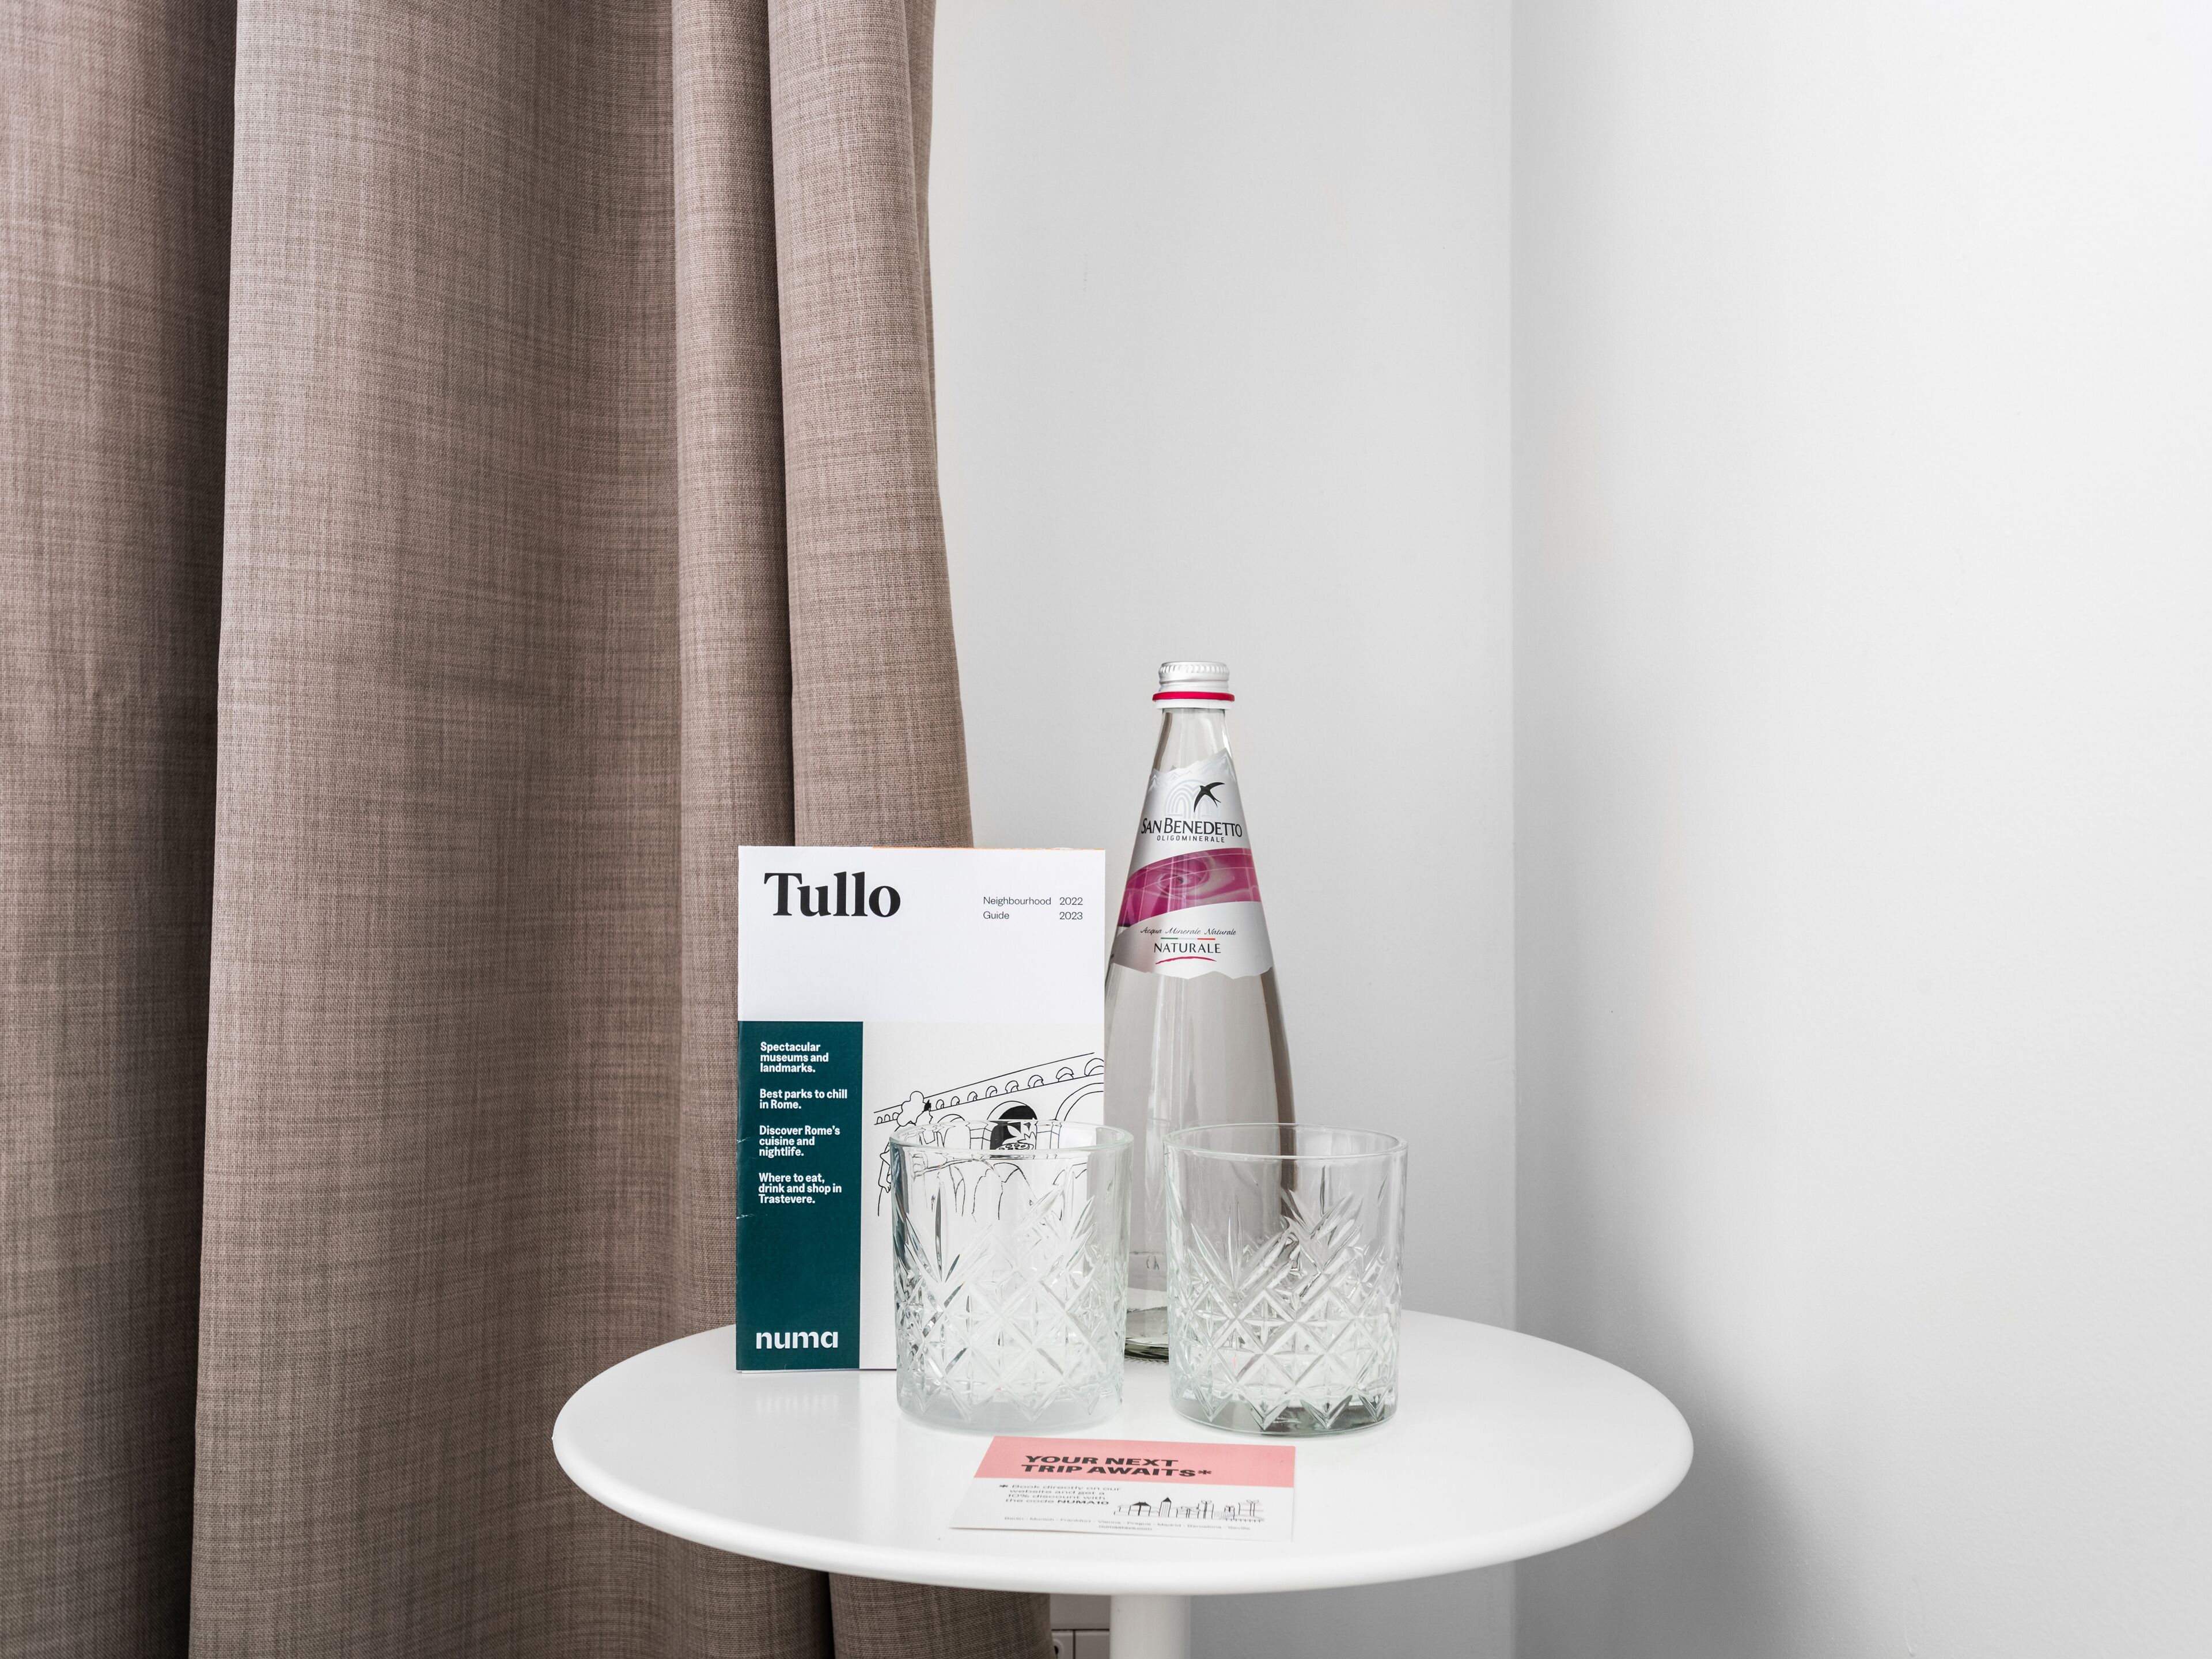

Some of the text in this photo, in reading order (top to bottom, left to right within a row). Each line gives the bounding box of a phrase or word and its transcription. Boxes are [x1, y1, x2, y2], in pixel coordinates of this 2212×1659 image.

[1141, 817, 1243, 838] SAN BENEDETTO
[1157, 835, 1225, 843] OLIGOMINERALE
[763, 871, 901, 918] Tullo
[983, 896, 1083, 907] Neighbourhood 2022
[983, 911, 1083, 921] Guide 2023
[1140, 926, 1162, 936] Acqua
[1165, 927, 1201, 935] Minerale
[1154, 943, 1221, 953] NATURALE
[760, 1041, 821, 1053] Spectacular
[760, 1052, 829, 1062] museums and
[760, 1062, 816, 1073] landmarks.
[760, 1088, 848, 1101] Best parks to chill
[759, 1099, 802, 1109] in Rome.
[759, 1125, 840, 1135] Discover Rome’s
[759, 1135, 815, 1146] cuisine and
[759, 1146, 804, 1158] nightlife.
[758, 1172, 825, 1185] Where to eat,
[758, 1183, 842, 1195] drink and shop in
[758, 1194, 816, 1204] Trastevere.
[756, 1331, 838, 1349] numa
[1025, 1455, 1179, 1467] YOUR NEXT
[1021, 1464, 1083, 1473] TRIP
